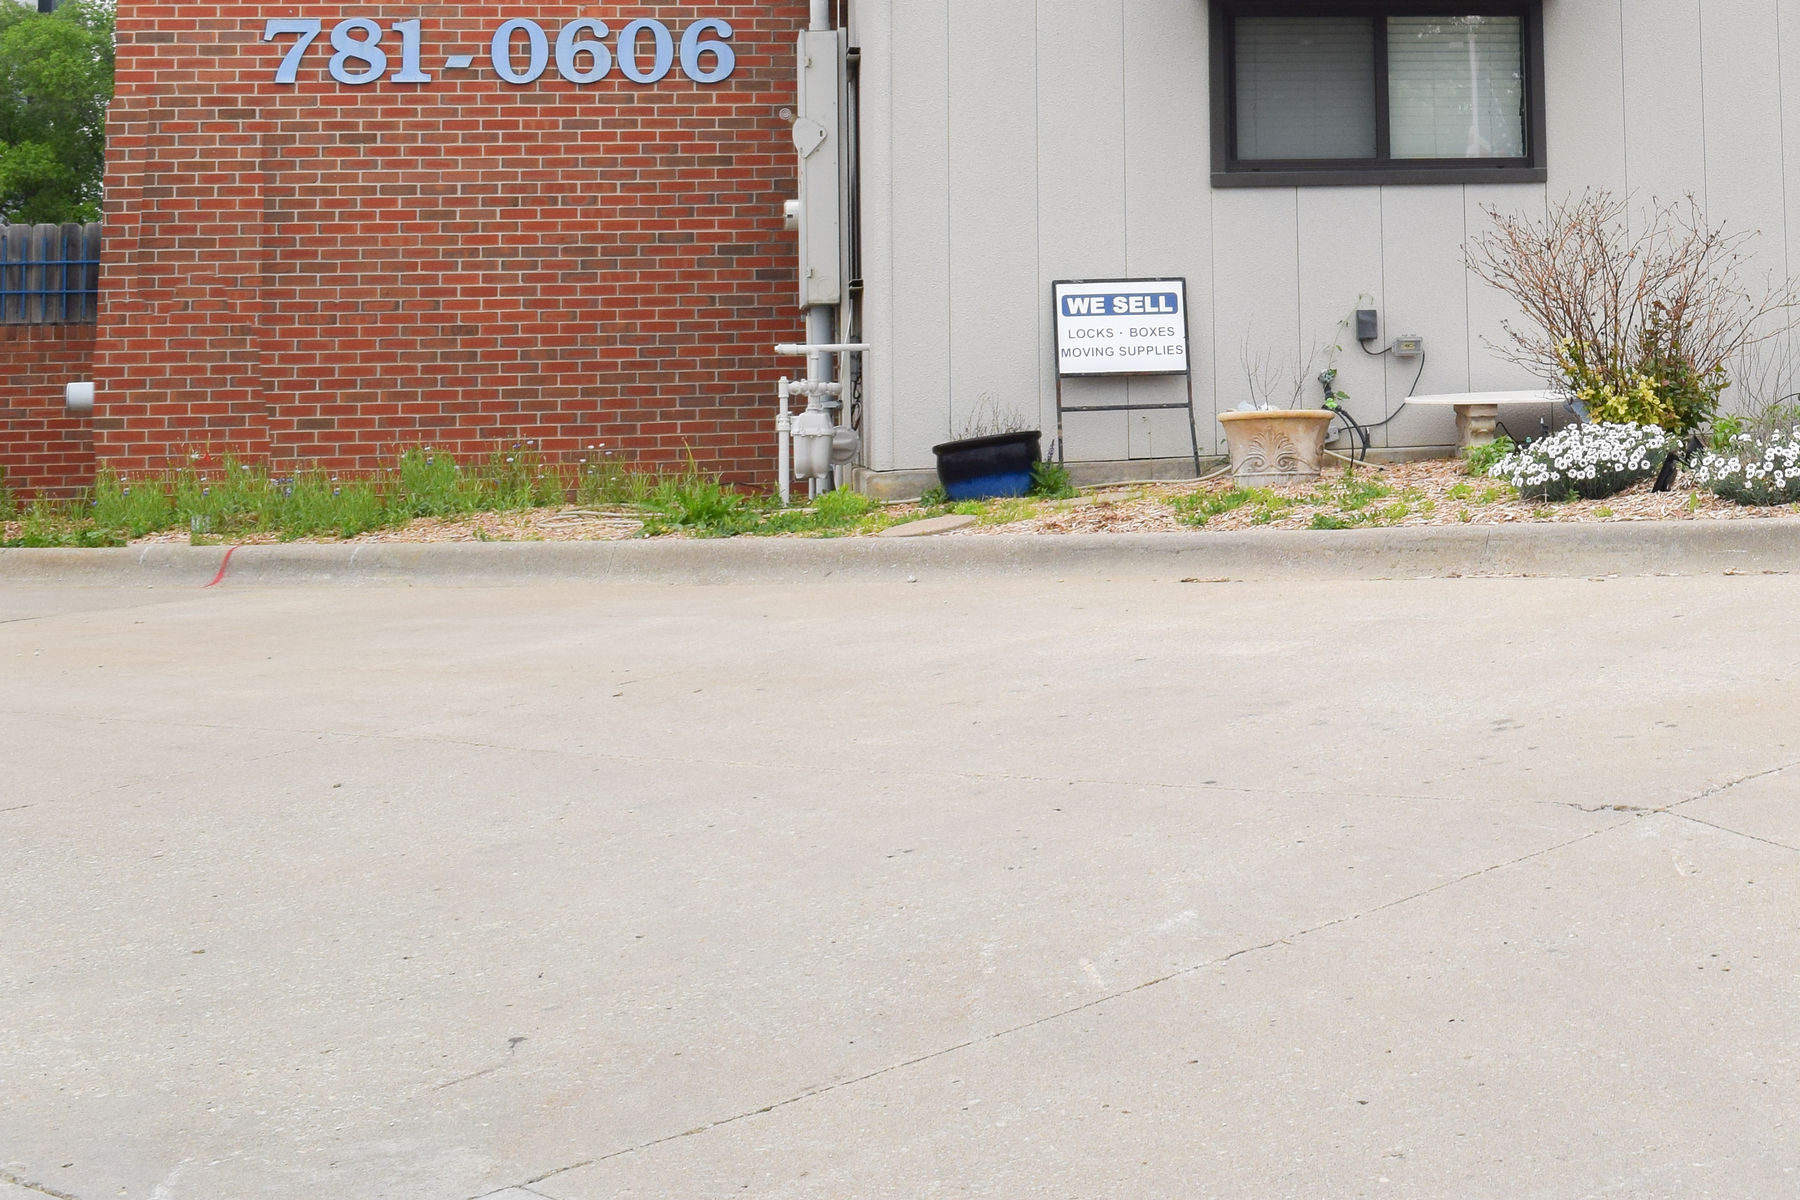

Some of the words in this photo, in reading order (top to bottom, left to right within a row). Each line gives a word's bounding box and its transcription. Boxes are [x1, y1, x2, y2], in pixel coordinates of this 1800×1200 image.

[263, 18, 736, 85] 781-0606
[1066, 296, 1106, 315] WE
[1113, 295, 1173, 314] SELL
[1068, 328, 1114, 339] LOCKS
[1129, 326, 1176, 338] BOXES
[1061, 346, 1116, 358] MOVING
[1119, 345, 1184, 357] SUPPLIES
